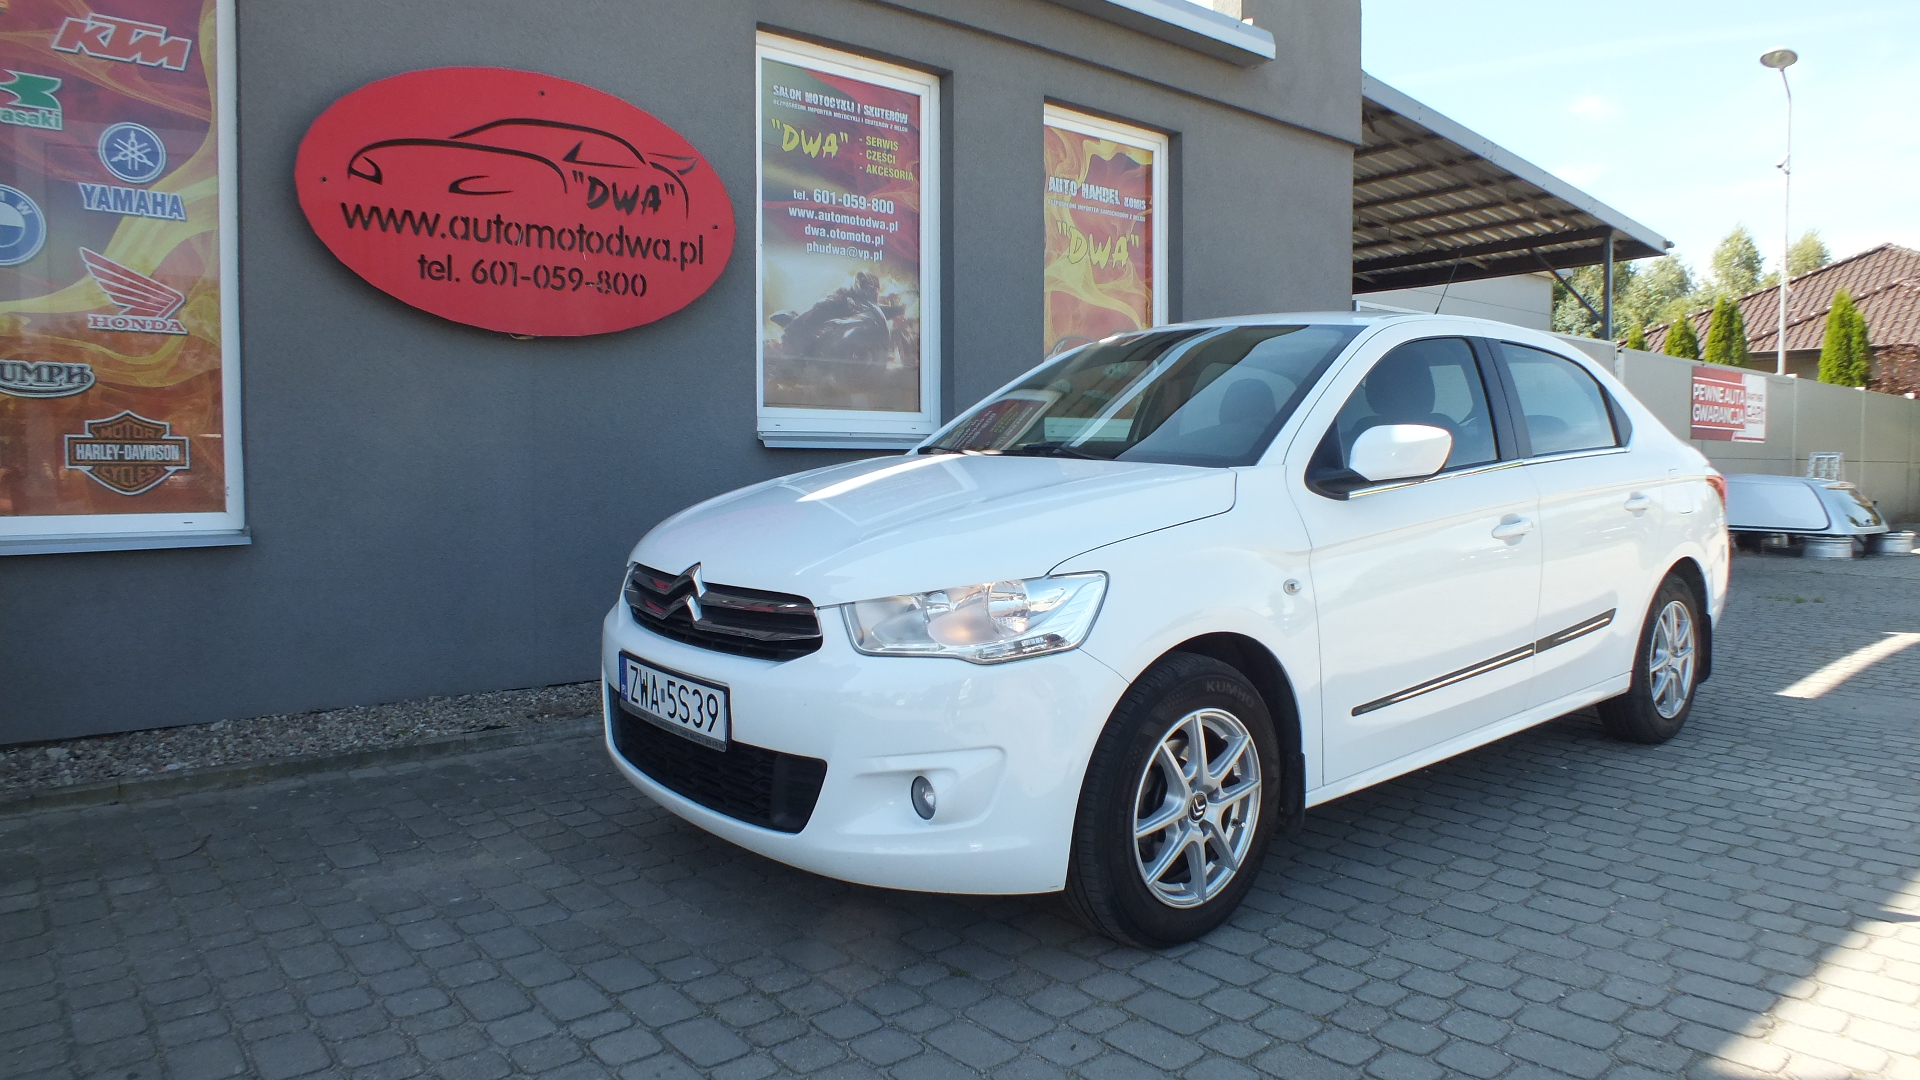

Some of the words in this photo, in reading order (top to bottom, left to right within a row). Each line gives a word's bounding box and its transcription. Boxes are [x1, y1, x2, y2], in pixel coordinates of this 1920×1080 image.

[52, 13, 192, 71] KTM
[773, 85, 801, 101] SALON
[805, 92, 855, 113] MOTOCYKLI
[864, 105, 908, 124] SKUTERÓW
[772, 119, 848, 158] "DWA"
[866, 136, 898, 151] SERWIS
[866, 150, 895, 164] CZĘŚCI
[866, 165, 913, 181] AKCESORIA
[78, 183, 187, 221] YAMAHA
[572, 170, 675, 215] "DWA"
[794, 190, 808, 200] tel.
[814, 189, 894, 214] 601-059-800
[1048, 177, 1077, 197] AUTO
[1082, 183, 1120, 205] HANDEL
[1124, 197, 1146, 210] KOMIS
[789, 207, 898, 232] www.automotodwa.pl
[340, 202, 704, 272] www.automotodwa.pl
[805, 224, 883, 245] dwa.otomoto.pl
[1057, 221, 1140, 269] "DWA"
[806, 242, 882, 261] phudwa@vp.pl
[418, 254, 460, 284] tel.
[471, 258, 648, 298] 601-059-800
[88, 313, 188, 334] HONDA
[1693, 384, 1723, 402] PEWNE
[1725, 388, 1744, 404] AUTA
[1693, 404, 1744, 424] GWARANCJA
[98, 419, 161, 439] MOTOR
[75, 442, 181, 462] HARLEY-DAVIDSON
[99, 465, 159, 485] CYCLES
[630, 664, 661, 714] ZWA
[667, 679, 719, 733] 5S39
